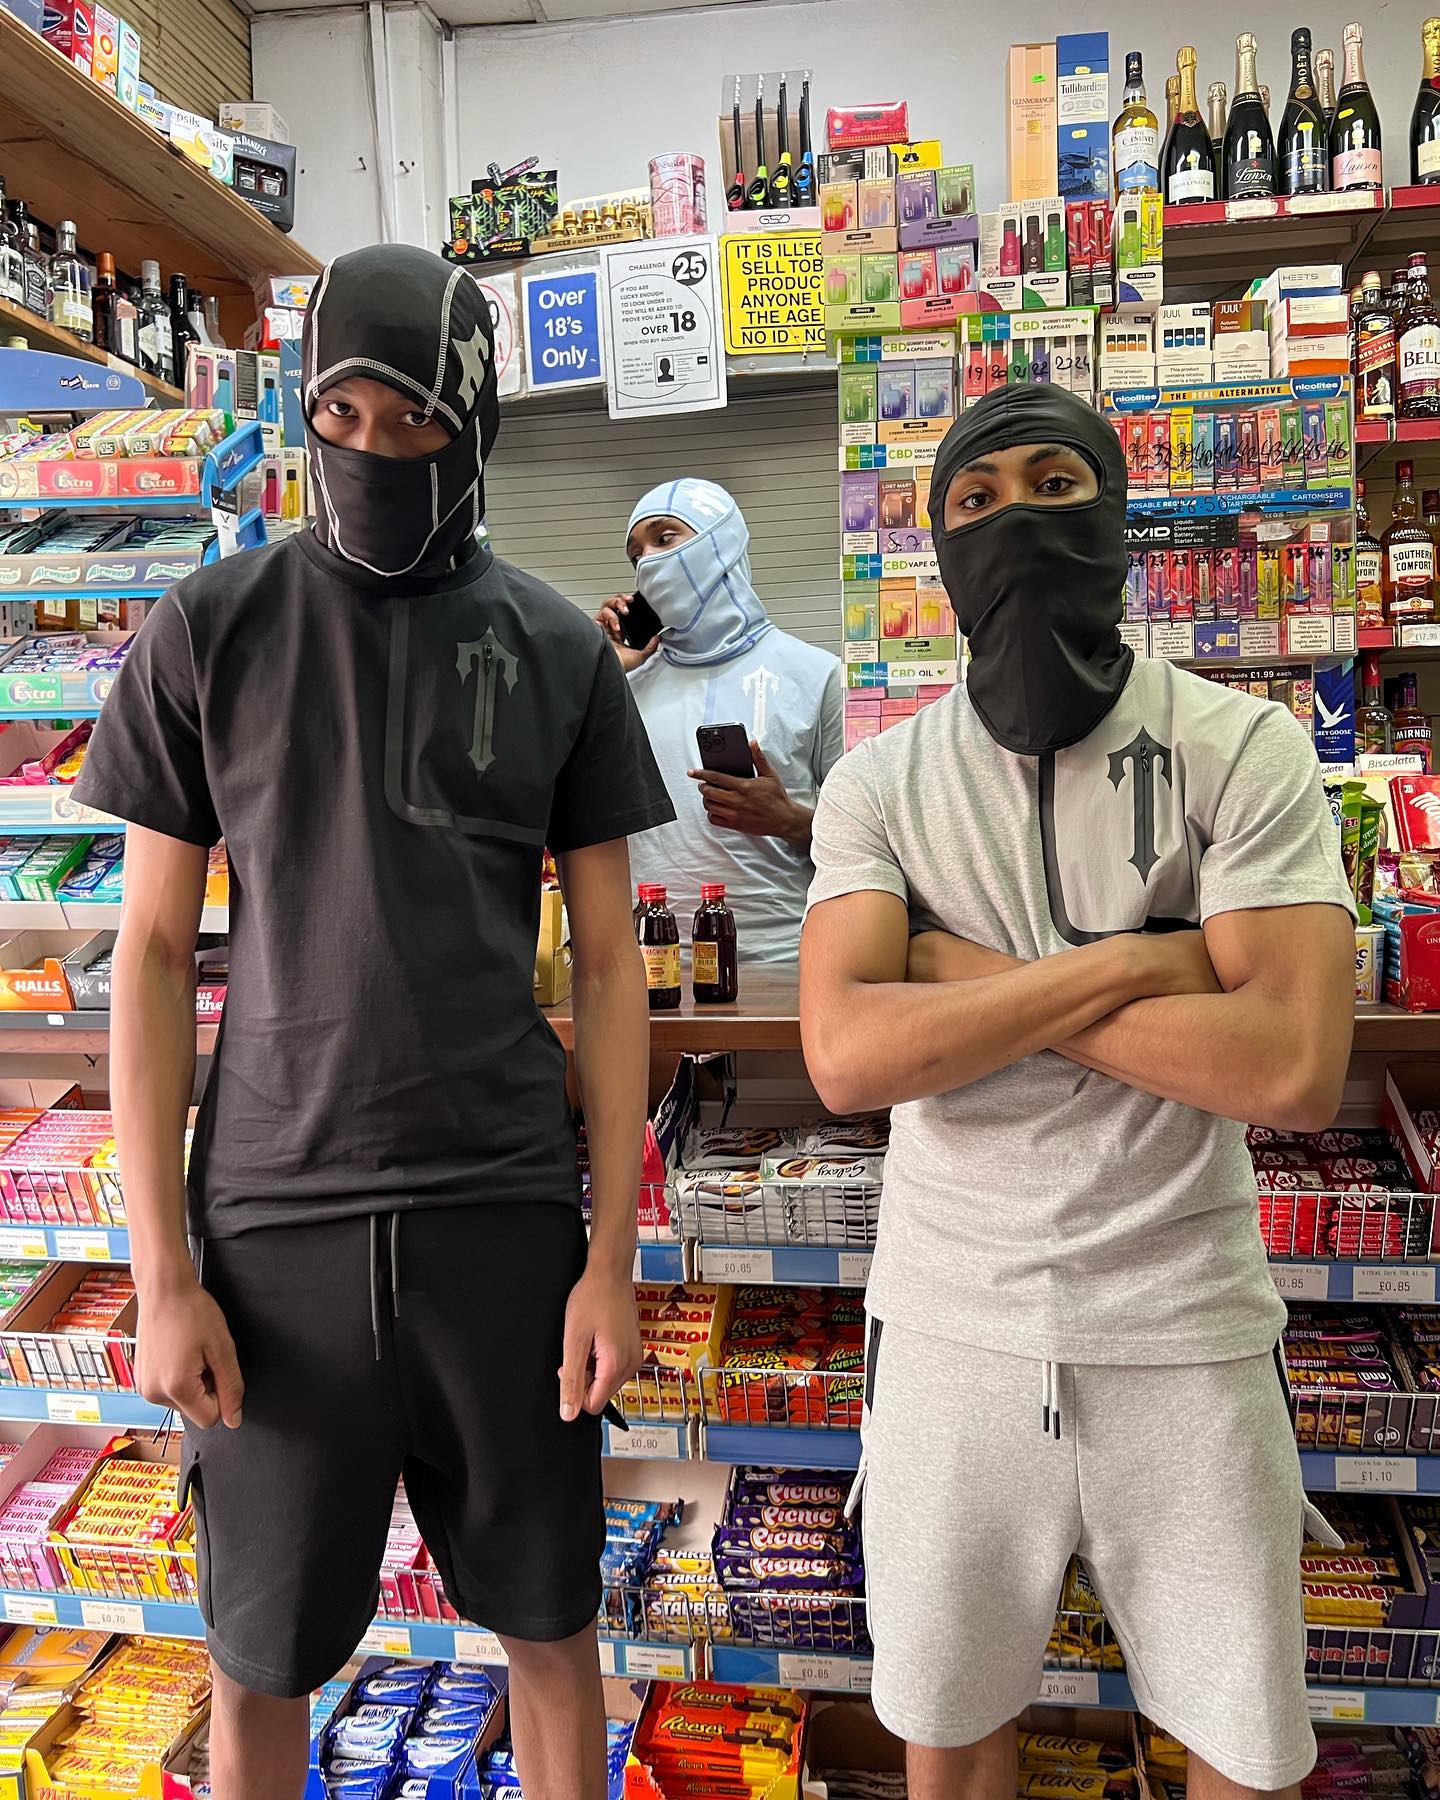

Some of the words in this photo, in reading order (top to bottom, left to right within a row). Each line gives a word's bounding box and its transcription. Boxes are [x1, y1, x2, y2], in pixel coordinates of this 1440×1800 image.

[900, 173, 915, 182] LOST
[915, 170, 931, 179] MARY
[1234, 167, 1272, 184] Lanson
[736, 245, 751, 258] IT
[757, 244, 772, 258] IS
[938, 245, 953, 254] LOST
[628, 261, 666, 272] CHALLENGE
[673, 255, 706, 281] 25
[742, 260, 785, 275] SELL
[748, 275, 824, 291] PRODUC
[1283, 273, 1319, 281] HEETS
[538, 290, 586, 310] Over
[741, 292, 811, 308] ANYONE
[745, 310, 779, 324] THE
[786, 309, 821, 323] AGE
[544, 316, 582, 338] 18's
[641, 324, 668, 336] OVER
[669, 311, 696, 333] 18
[1014, 320, 1039, 332] CBD
[742, 330, 766, 344] NO
[772, 330, 788, 343] ID
[882, 342, 906, 353] CBD
[1288, 344, 1325, 352] HEETS
[1360, 348, 1373, 360] RED
[1374, 341, 1395, 354] LABEL
[542, 345, 588, 369] Only
[968, 364, 983, 379] 19
[991, 364, 1007, 378] 20
[1032, 361, 1048, 375] 22
[1296, 381, 1338, 391] nicolites
[1116, 394, 1157, 402] nicolites
[1170, 393, 1187, 401] THE
[1192, 391, 1214, 400] REAL
[1219, 386, 1281, 397] ALTERNATIVE
[888, 449, 912, 459] CBD
[58, 474, 93, 488] Extra
[140, 474, 176, 488] Extra
[1292, 492, 1344, 501] CARTOMISERS
[1334, 547, 1352, 562] 35
[1393, 550, 1431, 562] SOUTHERN
[1396, 562, 1431, 572] COMFORT
[891, 669, 916, 678] CBD
[919, 669, 933, 677] OIL
[1250, 670, 1274, 679] £1.99
[14, 685, 56, 700] Extra
[1368, 756, 1415, 769] Biscolata
[15, 980, 63, 993] HALLS
[699, 1128, 744, 1138] Galaxy
[817, 1160, 865, 1177] Galaxy
[684, 1171, 731, 1180] Galaxy
[725, 1263, 751, 1273] £0.85
[1274, 1278, 1304, 1288] £0.85
[1379, 1282, 1410, 1292] £0.85
[621, 1394, 712, 1406] TOBLERONE
[631, 1439, 658, 1449] £0.80
[1361, 1472, 1392, 1481] £1.10
[768, 1484, 840, 1503] Picnic
[1, 1509, 48, 1521] Fruit-tella
[763, 1507, 833, 1528] Picnic
[752, 1528, 824, 1547] Picnic
[651, 1602, 728, 1617] STARBAR
[101, 1614, 125, 1624] £0.70
[802, 1670, 829, 1679] £0.85
[672, 1686, 736, 1704] Reese's
[1047, 1685, 1076, 1695] £0.80
[660, 1715, 725, 1735] Reese's
[633, 1776, 643, 1784] 40
